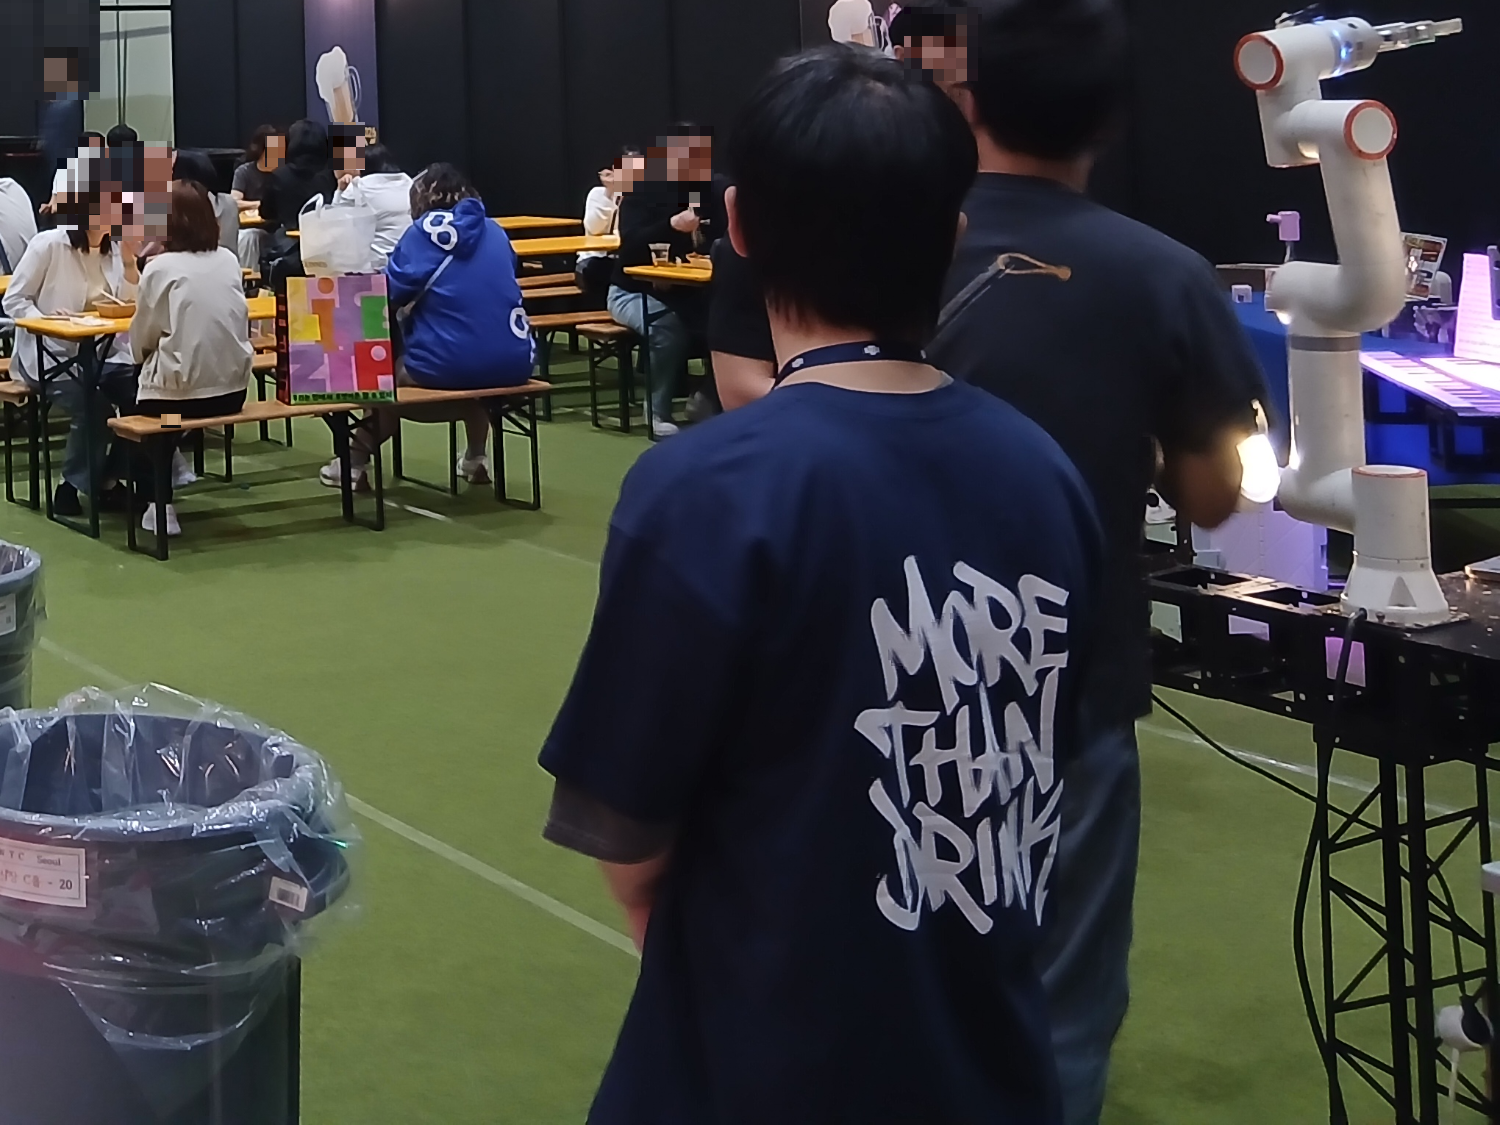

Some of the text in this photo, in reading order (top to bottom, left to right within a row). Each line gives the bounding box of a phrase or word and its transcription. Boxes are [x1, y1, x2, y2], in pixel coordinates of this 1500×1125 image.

[871, 554, 1070, 715] MORE
[854, 667, 1061, 817] THAN
[59, 879, 73, 890] 20
